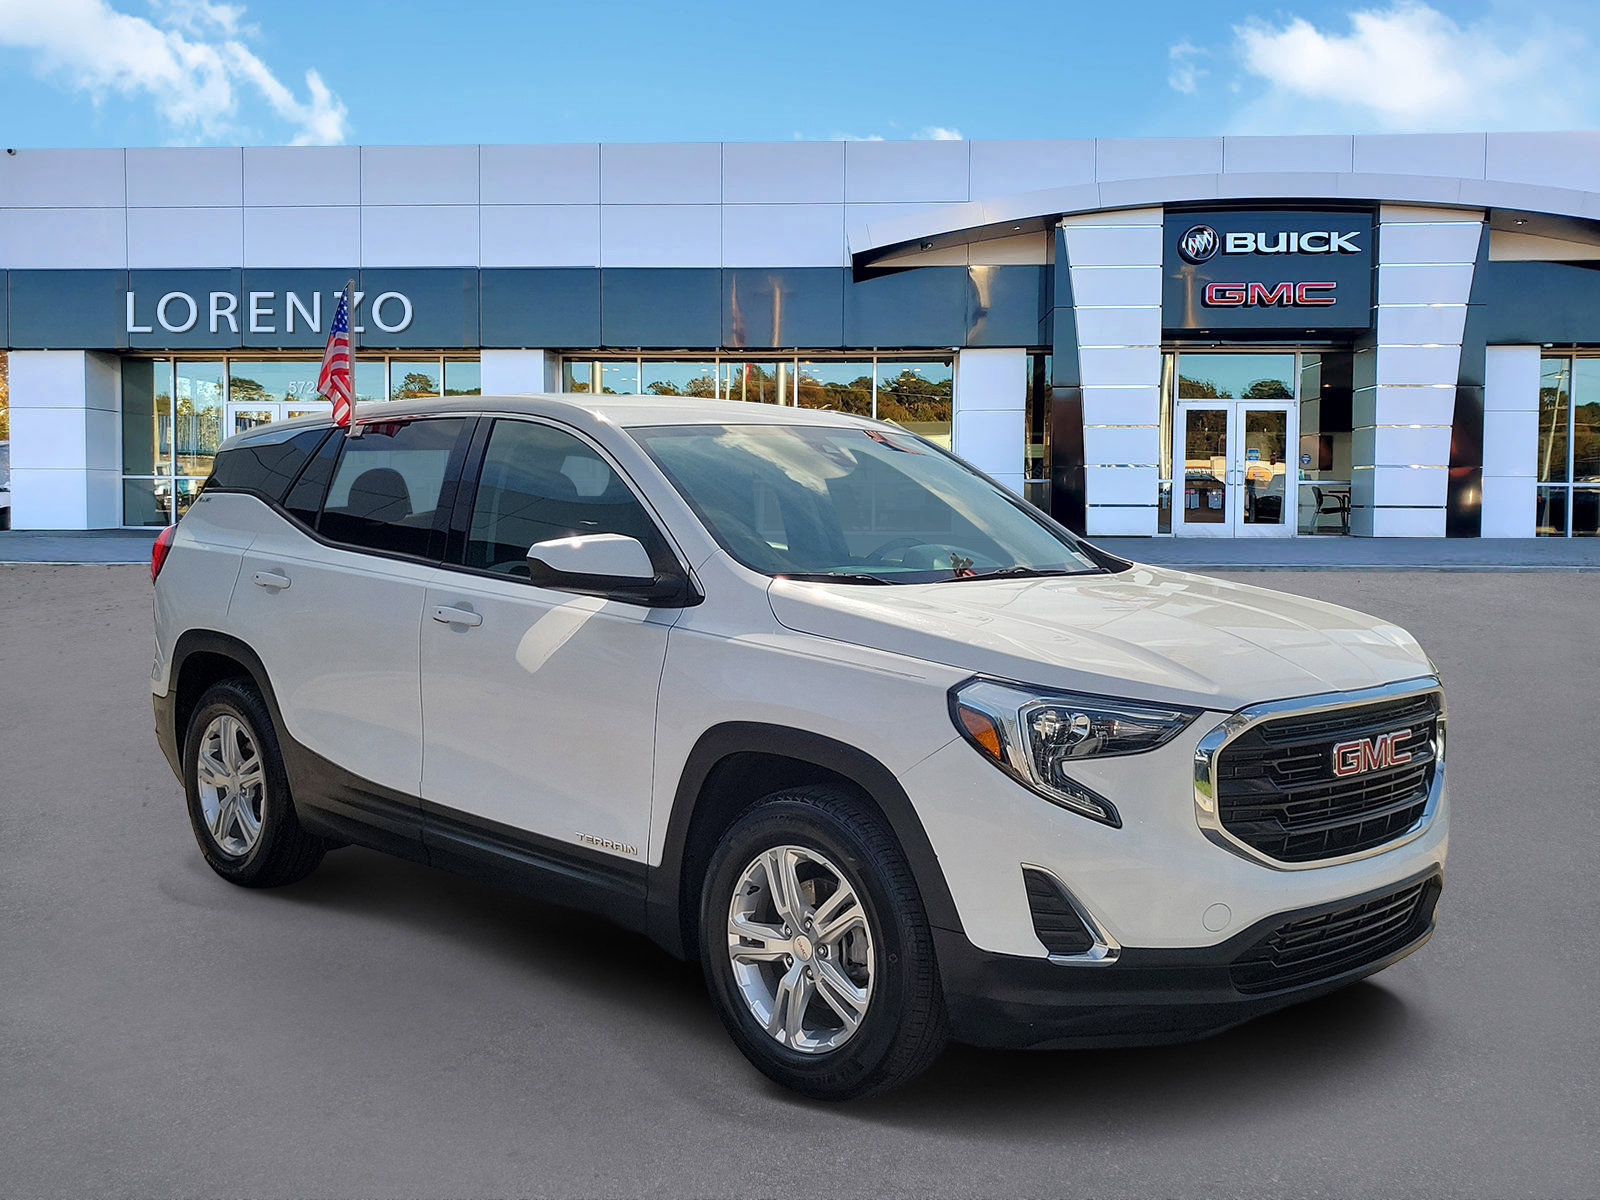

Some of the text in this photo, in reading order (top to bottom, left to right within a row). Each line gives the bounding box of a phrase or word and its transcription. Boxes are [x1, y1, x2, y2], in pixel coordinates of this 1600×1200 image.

[1225, 231, 1362, 254] BUICK
[1204, 282, 1337, 306] GMC
[288, 380, 319, 395] 572
[1333, 729, 1412, 777] GMC
[575, 831, 638, 855] TERRAIN
